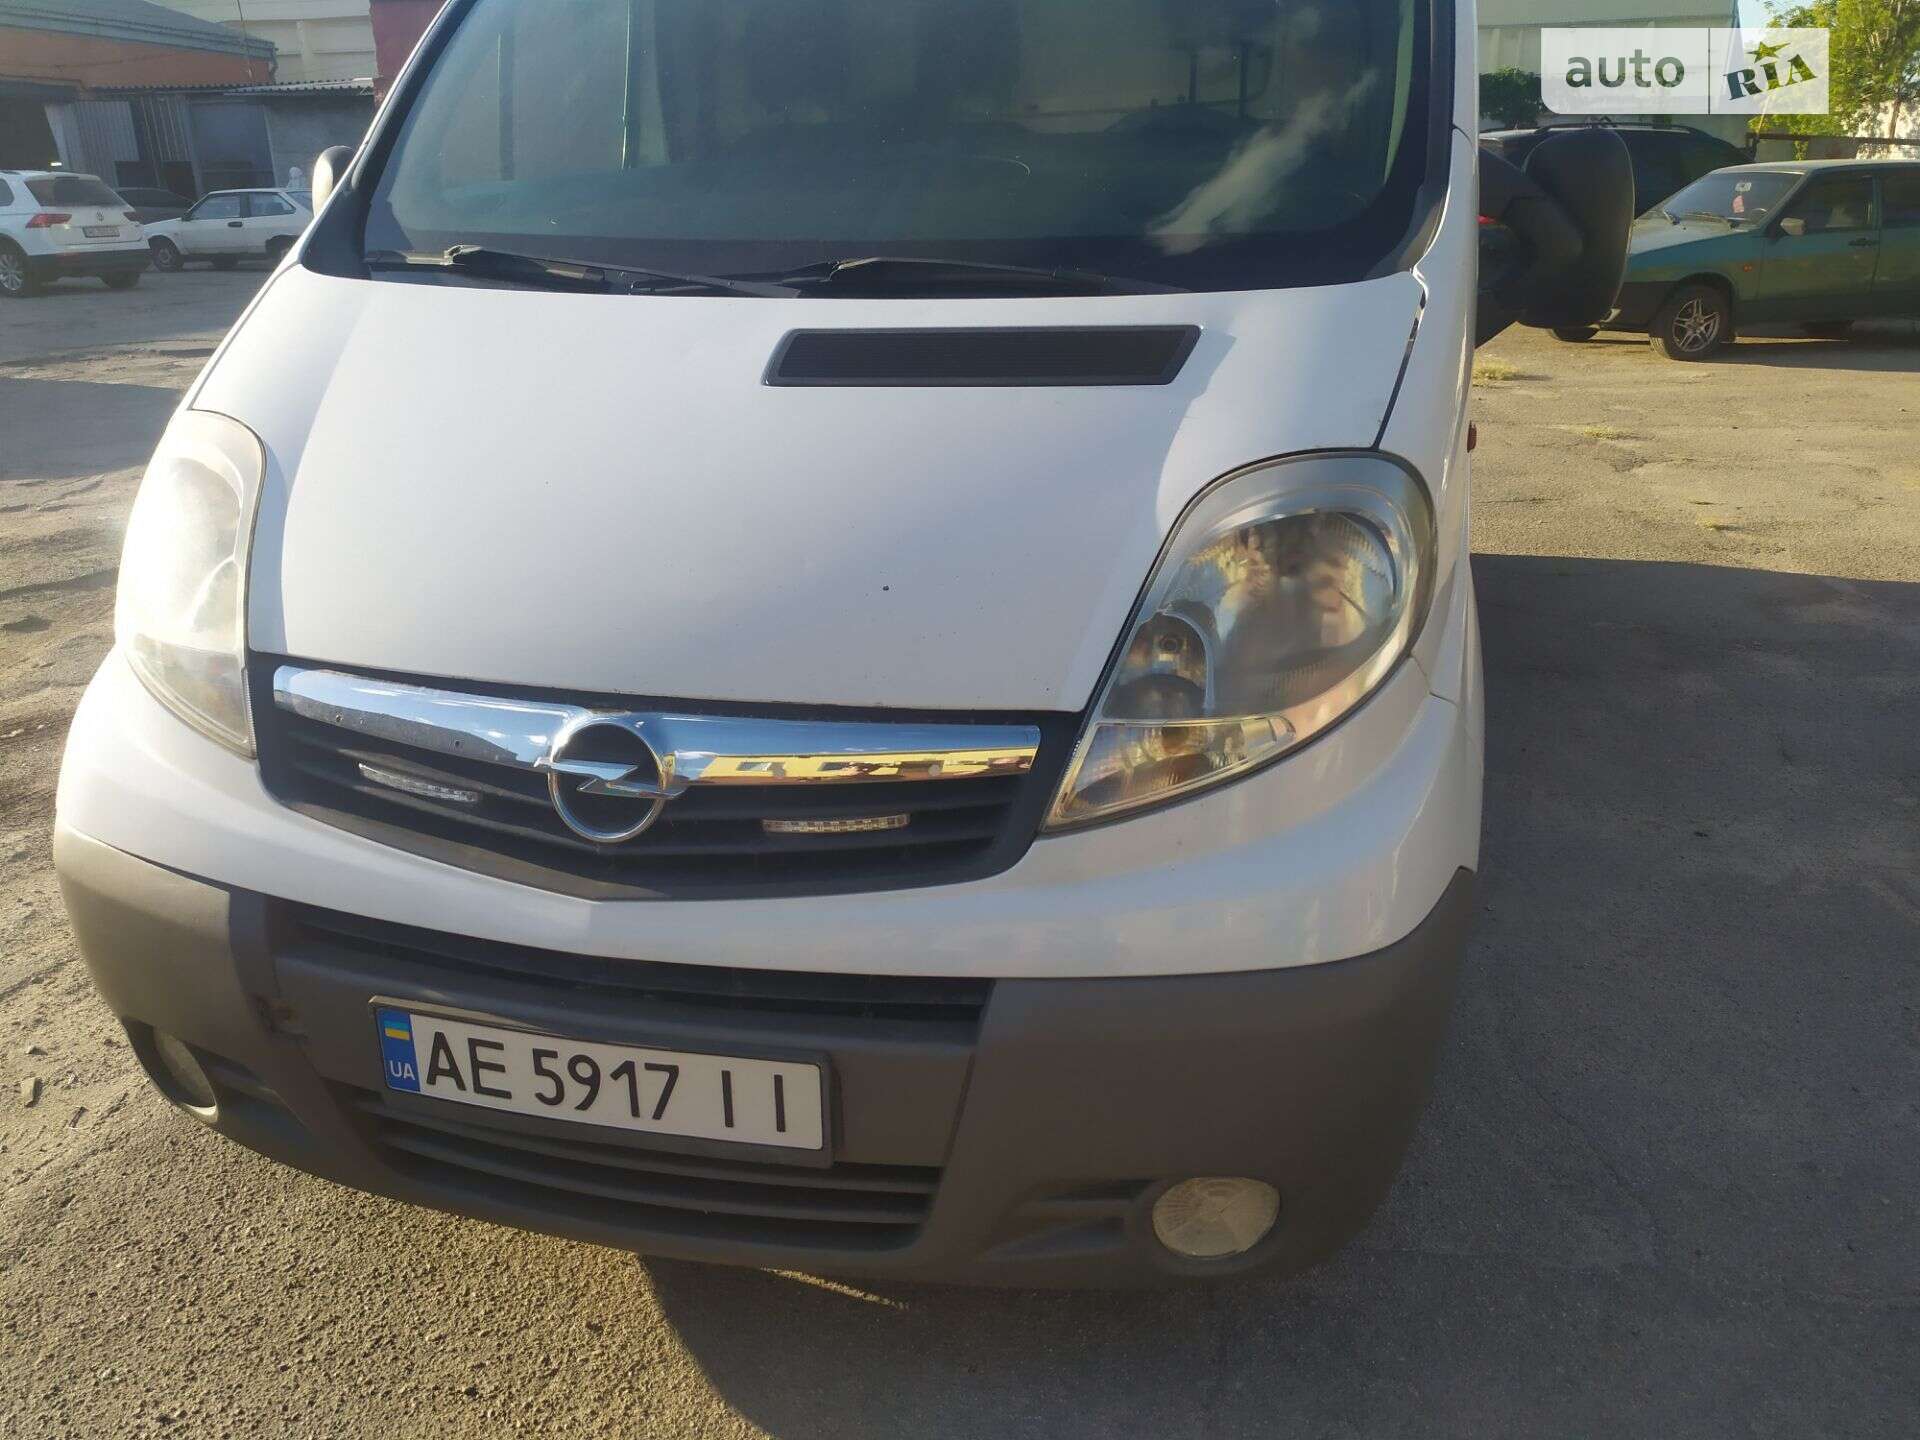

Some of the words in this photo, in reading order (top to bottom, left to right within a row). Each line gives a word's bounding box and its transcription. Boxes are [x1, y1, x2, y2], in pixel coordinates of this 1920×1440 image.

[389, 1060, 416, 1081] UA
[426, 1031, 512, 1099] AE
[532, 1048, 680, 1120] 5917
